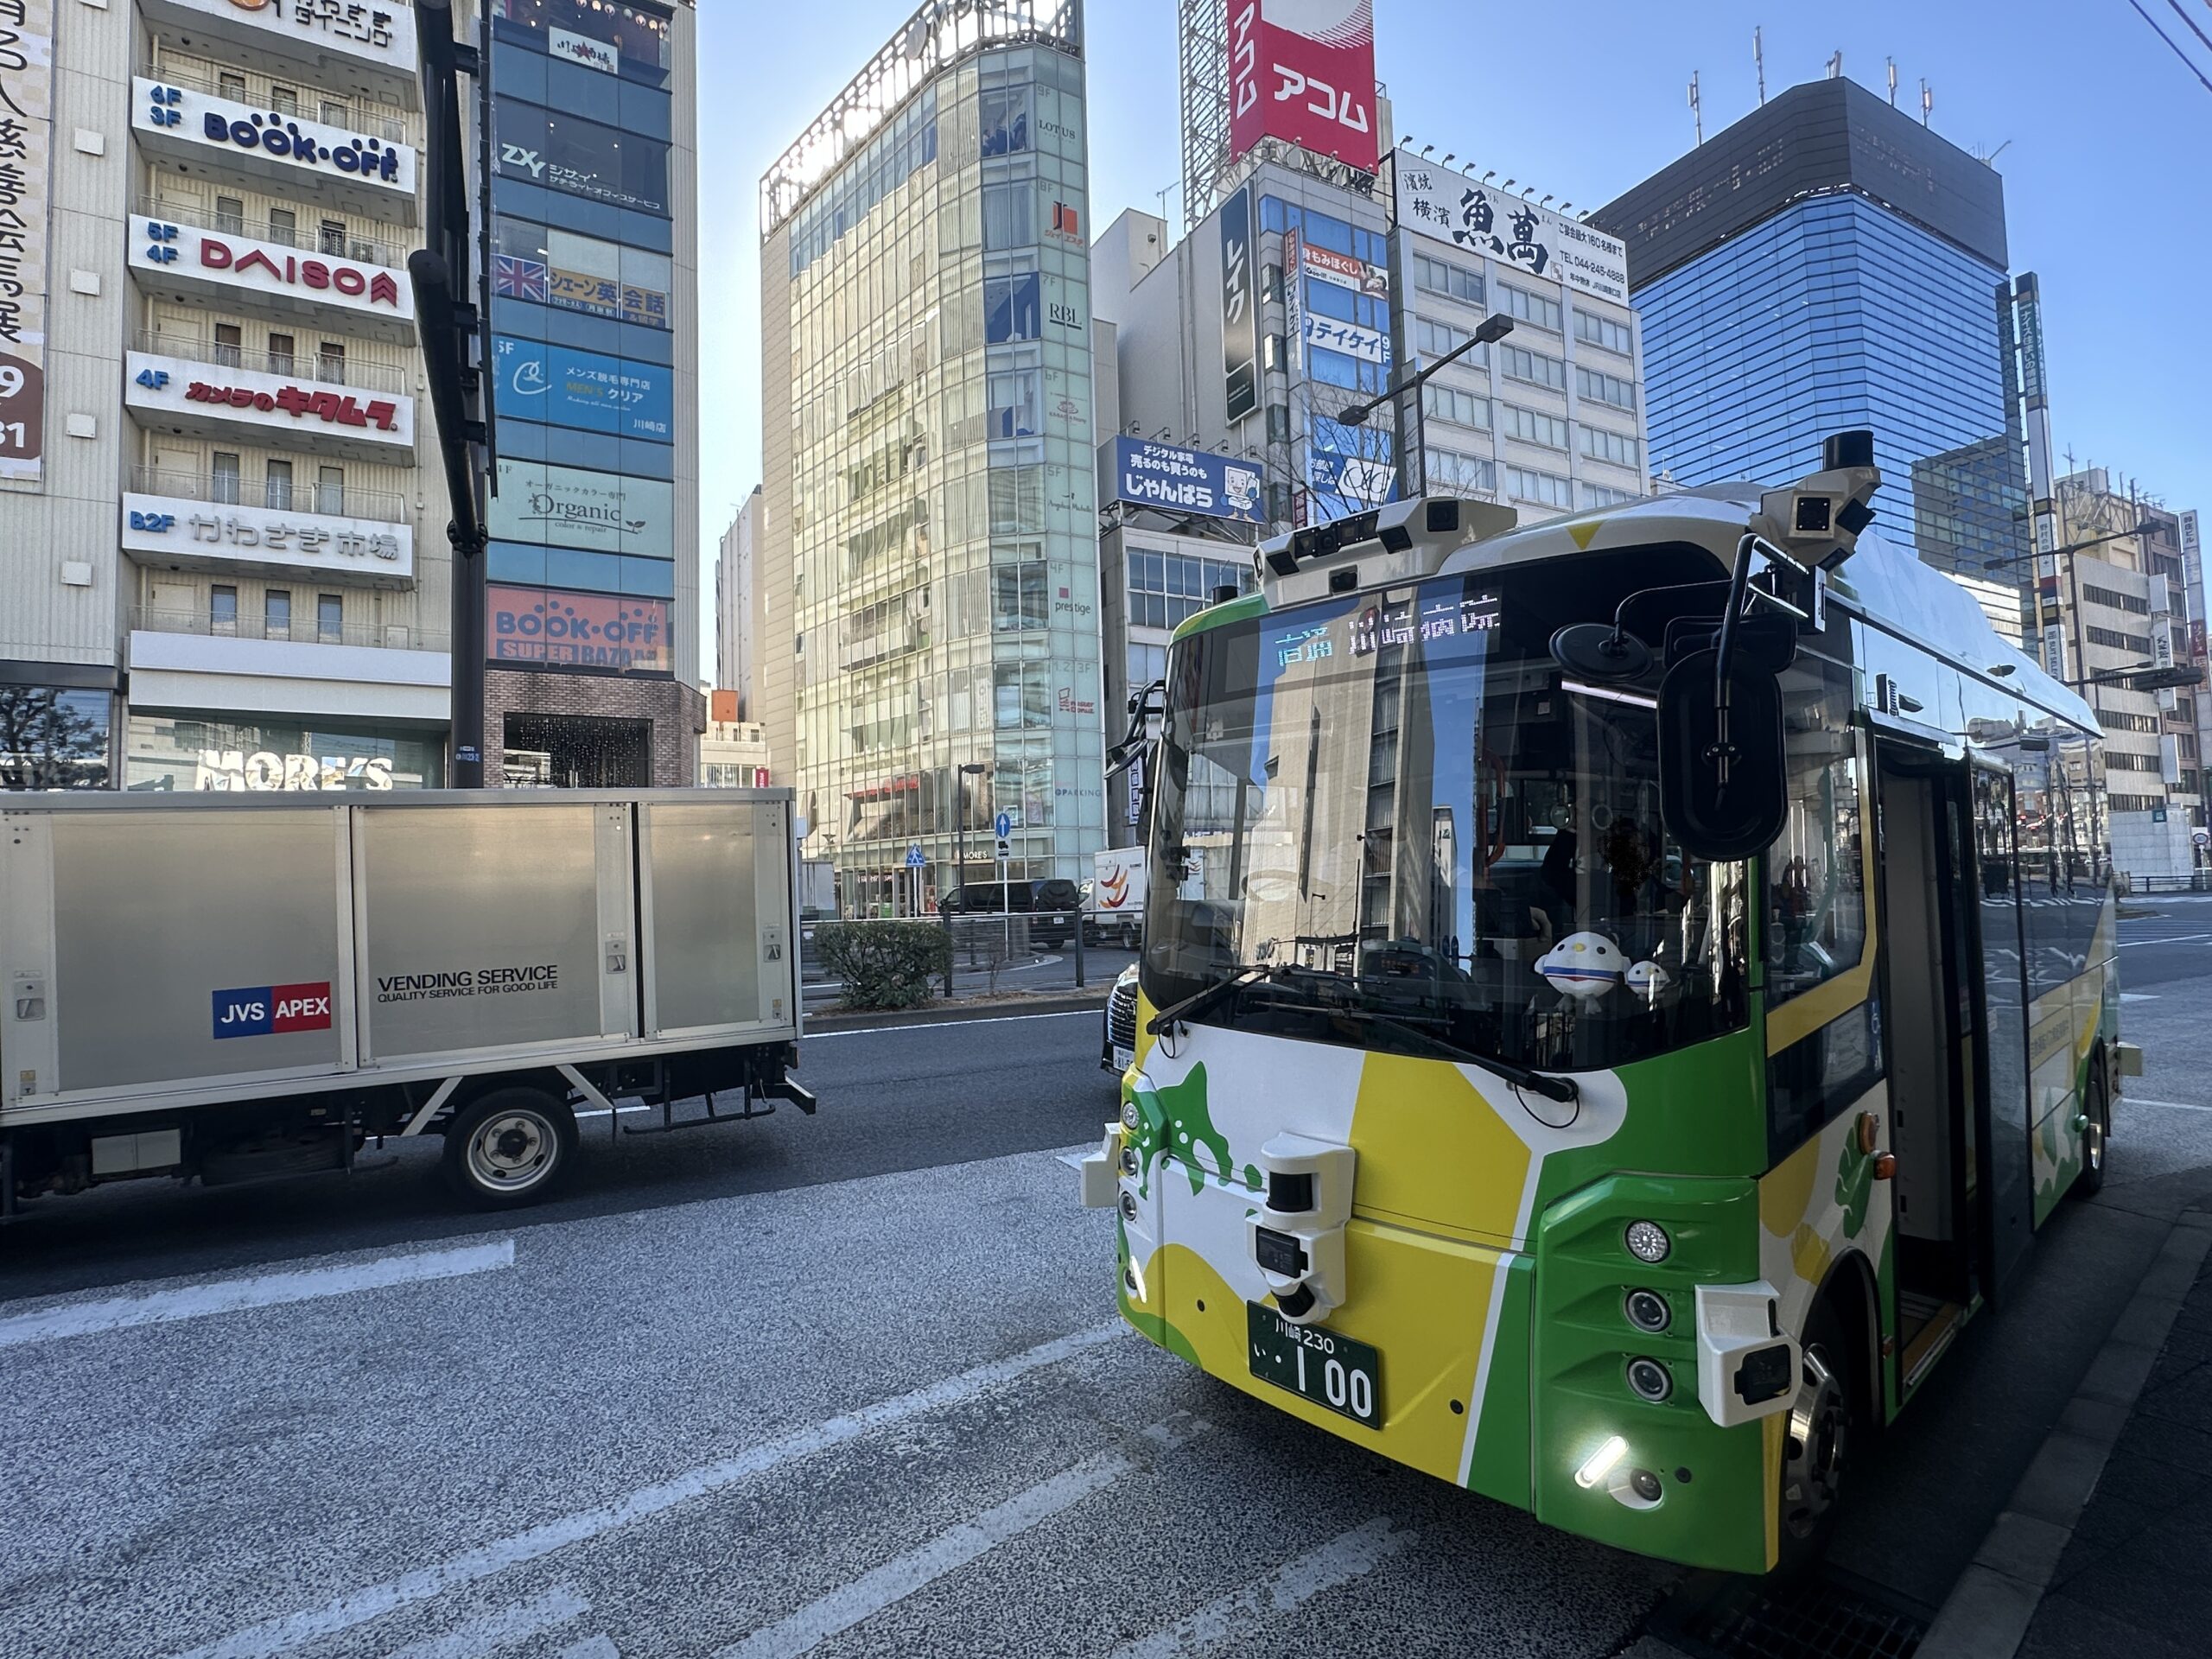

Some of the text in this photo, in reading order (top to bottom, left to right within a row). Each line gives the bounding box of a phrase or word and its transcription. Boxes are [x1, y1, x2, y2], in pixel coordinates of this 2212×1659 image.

[1273, 62, 1369, 133] アコム
[150, 106, 181, 127] 3F
[1039, 119, 1076, 139] LOTUS
[502, 143, 546, 178] ZXY
[147, 222, 179, 243] 5F
[146, 245, 179, 264] 4F
[1560, 250, 1573, 264] TEL
[201, 238, 366, 296] DAISO
[1226, 238, 1245, 324] レイク
[136, 369, 170, 390] 4F
[185, 381, 397, 430] カメラのキタムラ
[607, 388, 644, 404] クリア
[633, 418, 667, 433] 川崎店
[1143, 445, 1194, 464] デジタル家電
[1130, 454, 1208, 479] 売るのも買うのも
[533, 493, 621, 523] Organic
[130, 511, 175, 533] B2F
[189, 513, 398, 560] かわさき市場
[1055, 602, 1090, 615] prestige
[503, 642, 574, 663] SUPER
[194, 749, 393, 792] MORE'S
[378, 965, 558, 992] VENDING SERVICE
[378, 980, 558, 1003] QUALITY SERVICE FOR GOOD LIFE
[220, 996, 329, 1023] JVS APEX
